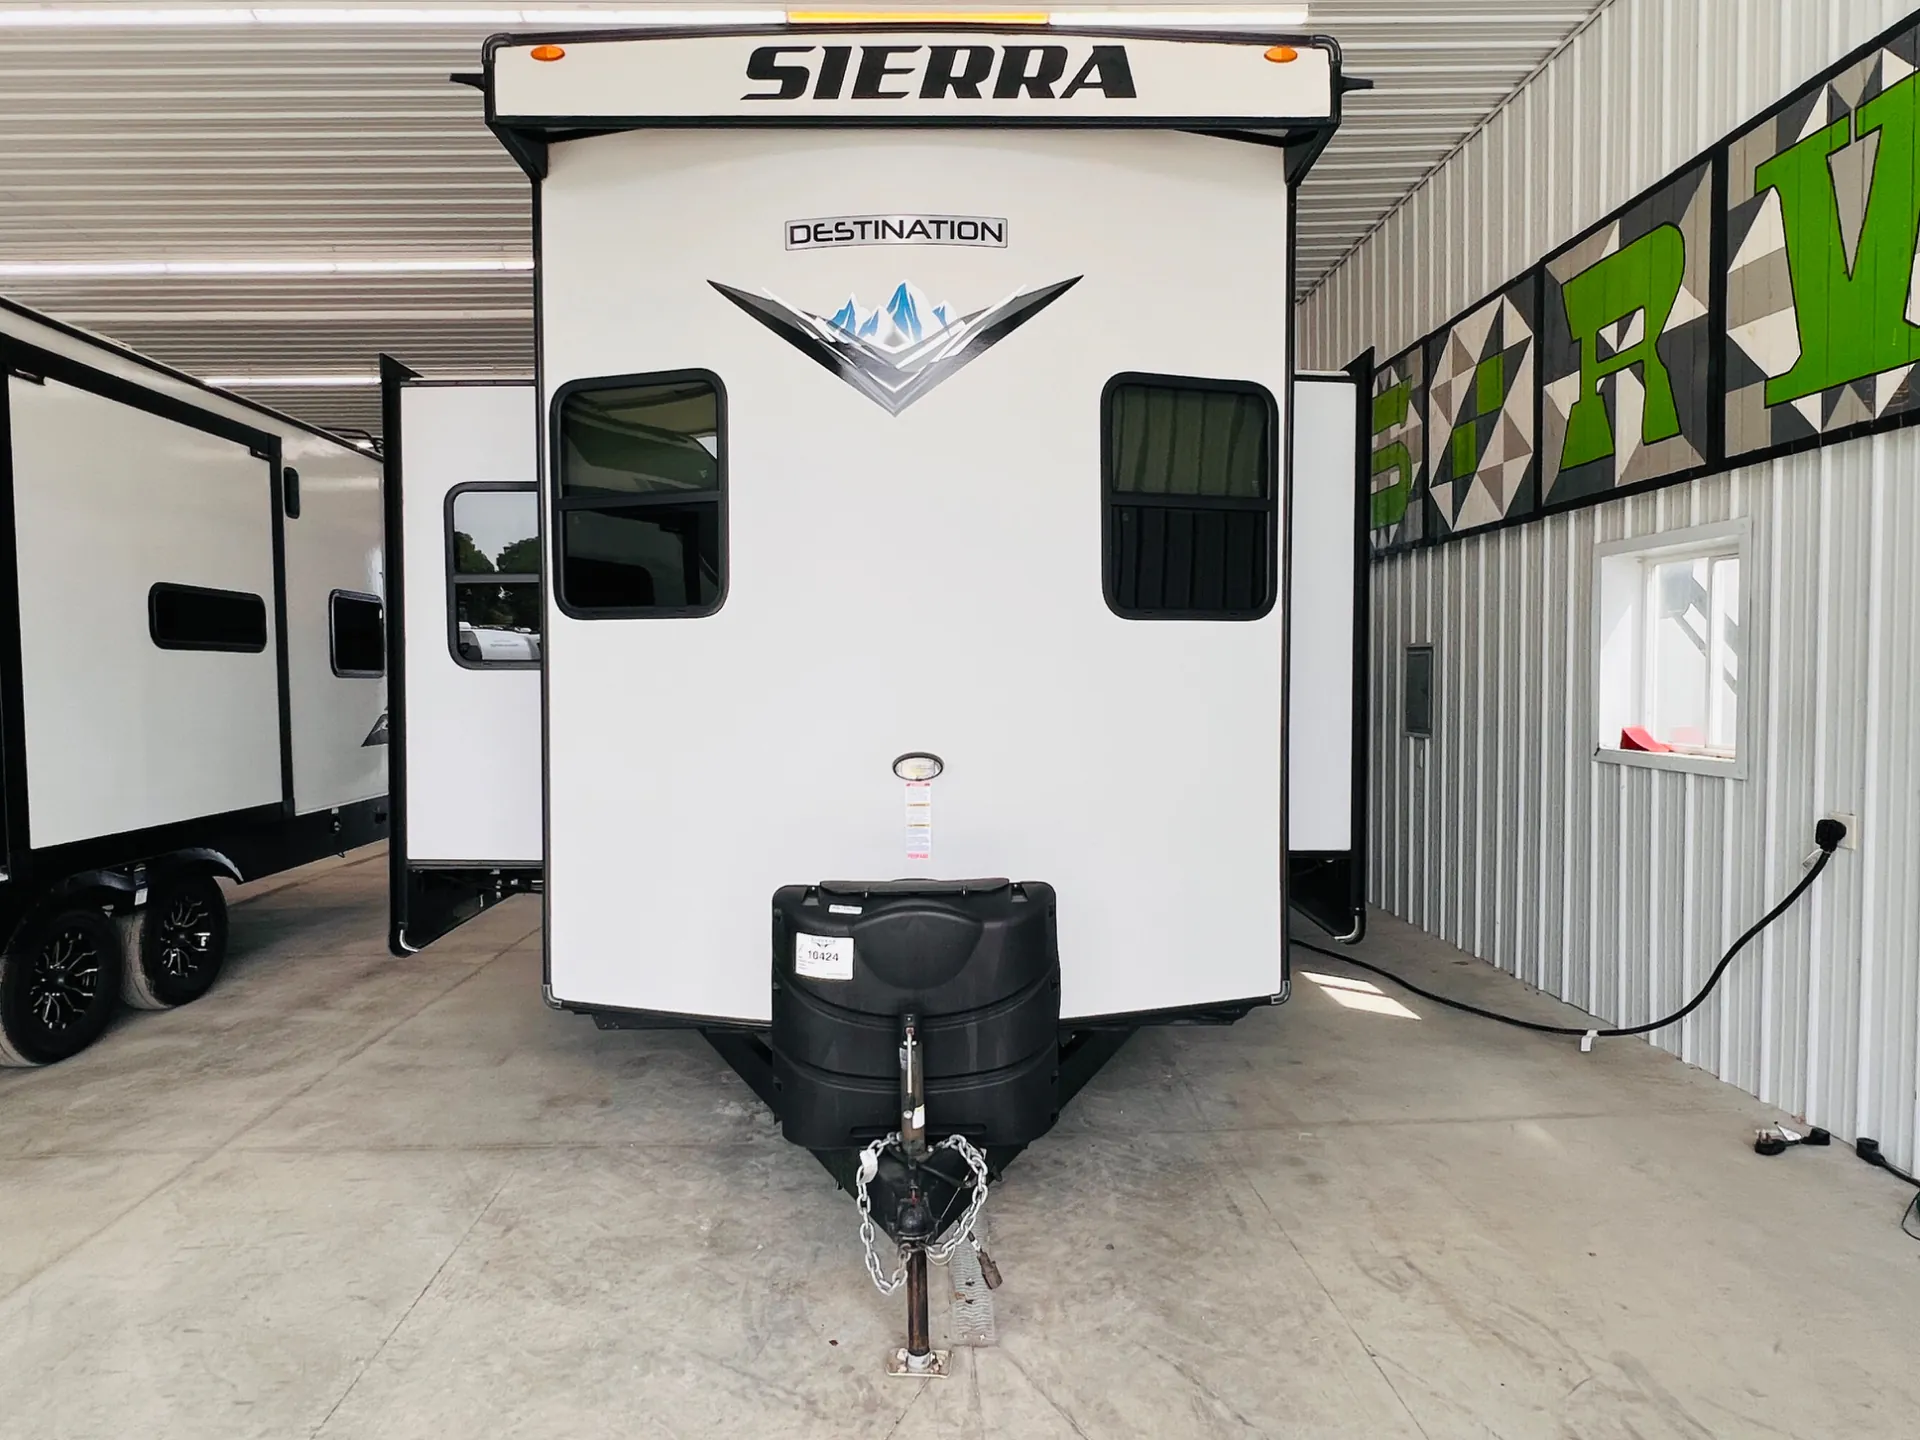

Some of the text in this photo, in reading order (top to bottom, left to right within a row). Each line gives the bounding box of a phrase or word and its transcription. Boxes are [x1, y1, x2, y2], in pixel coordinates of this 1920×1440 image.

[740, 45, 1137, 100] SIERRA
[789, 218, 1003, 246] DESTINATION
[808, 950, 839, 961] 10424
